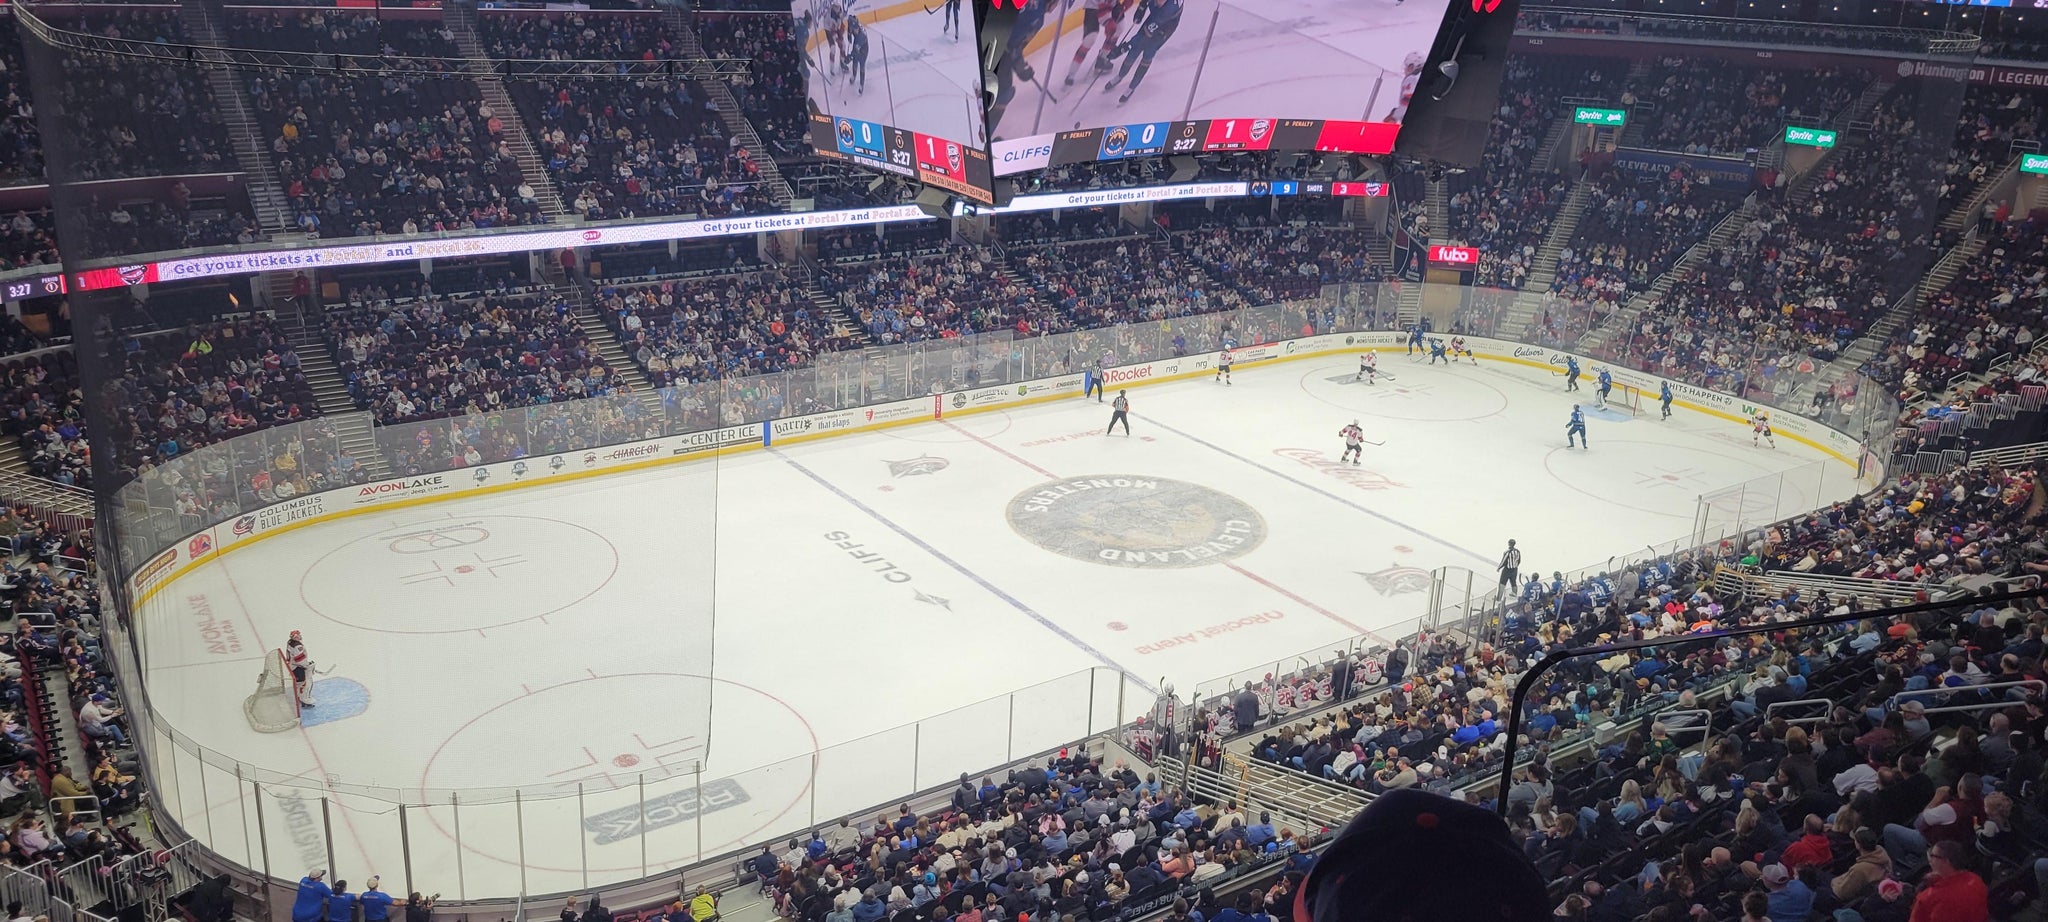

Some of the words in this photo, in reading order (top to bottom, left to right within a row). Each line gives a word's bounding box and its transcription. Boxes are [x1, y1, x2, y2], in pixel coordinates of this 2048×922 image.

[1915, 62, 1985, 82] Huntington
[1578, 111, 1602, 121] Sprite
[862, 122, 872, 144] 0
[1070, 130, 1092, 138] PENALTY
[1142, 124, 1154, 144] 0
[1226, 120, 1235, 138] 1
[1788, 130, 1813, 142] Sprite
[926, 138, 934, 159] 1
[1174, 138, 1196, 150] 3:27
[892, 149, 910, 166] 3:27
[1004, 145, 1050, 162] CLIFFS
[1619, 160, 1670, 174] CLEVELAND
[1084, 194, 1104, 204] your
[1106, 192, 1134, 200] tickets
[1146, 189, 1171, 198] Portal
[1178, 188, 1194, 196] and
[1196, 186, 1221, 194] Portal
[1284, 184, 1290, 193] 9
[1340, 184, 1347, 194] 3
[703, 222, 722, 233] Get
[725, 220, 752, 235] your
[754, 216, 792, 229] tickets
[794, 216, 805, 226] at
[808, 214, 840, 226] Portal
[851, 211, 870, 221] and
[872, 209, 902, 220] Portal
[904, 208, 920, 218] 26.
[174, 262, 201, 275] Get
[205, 259, 243, 274] your
[248, 254, 301, 269] tickets
[306, 253, 321, 264] at
[386, 245, 414, 257] and
[418, 242, 460, 256] Portal
[1438, 247, 1468, 262] fubo
[9, 284, 31, 298] 3:27
[1514, 346, 1544, 358] Culver's
[1110, 364, 1152, 383] Rocket
[1166, 365, 1178, 374] nrg
[1196, 360, 1208, 369] nrg
[1670, 382, 1688, 393] HITS
[1690, 388, 1723, 402] HAPPEN
[818, 421, 831, 430] that
[832, 418, 850, 428] slaps
[691, 430, 736, 446] CENTER
[738, 426, 756, 438] ICE
[614, 446, 645, 460] CHARGE
[1024, 478, 1158, 514] MONSTERS
[260, 496, 322, 518] COLUMBUS
[262, 515, 282, 530] BLUE
[287, 504, 322, 522] JACKETS
[1100, 519, 1251, 562] CLEVELAND
[824, 530, 912, 583] CLIFFS
[1530, 589, 1540, 601] 37
[1134, 632, 1198, 655] Arena
